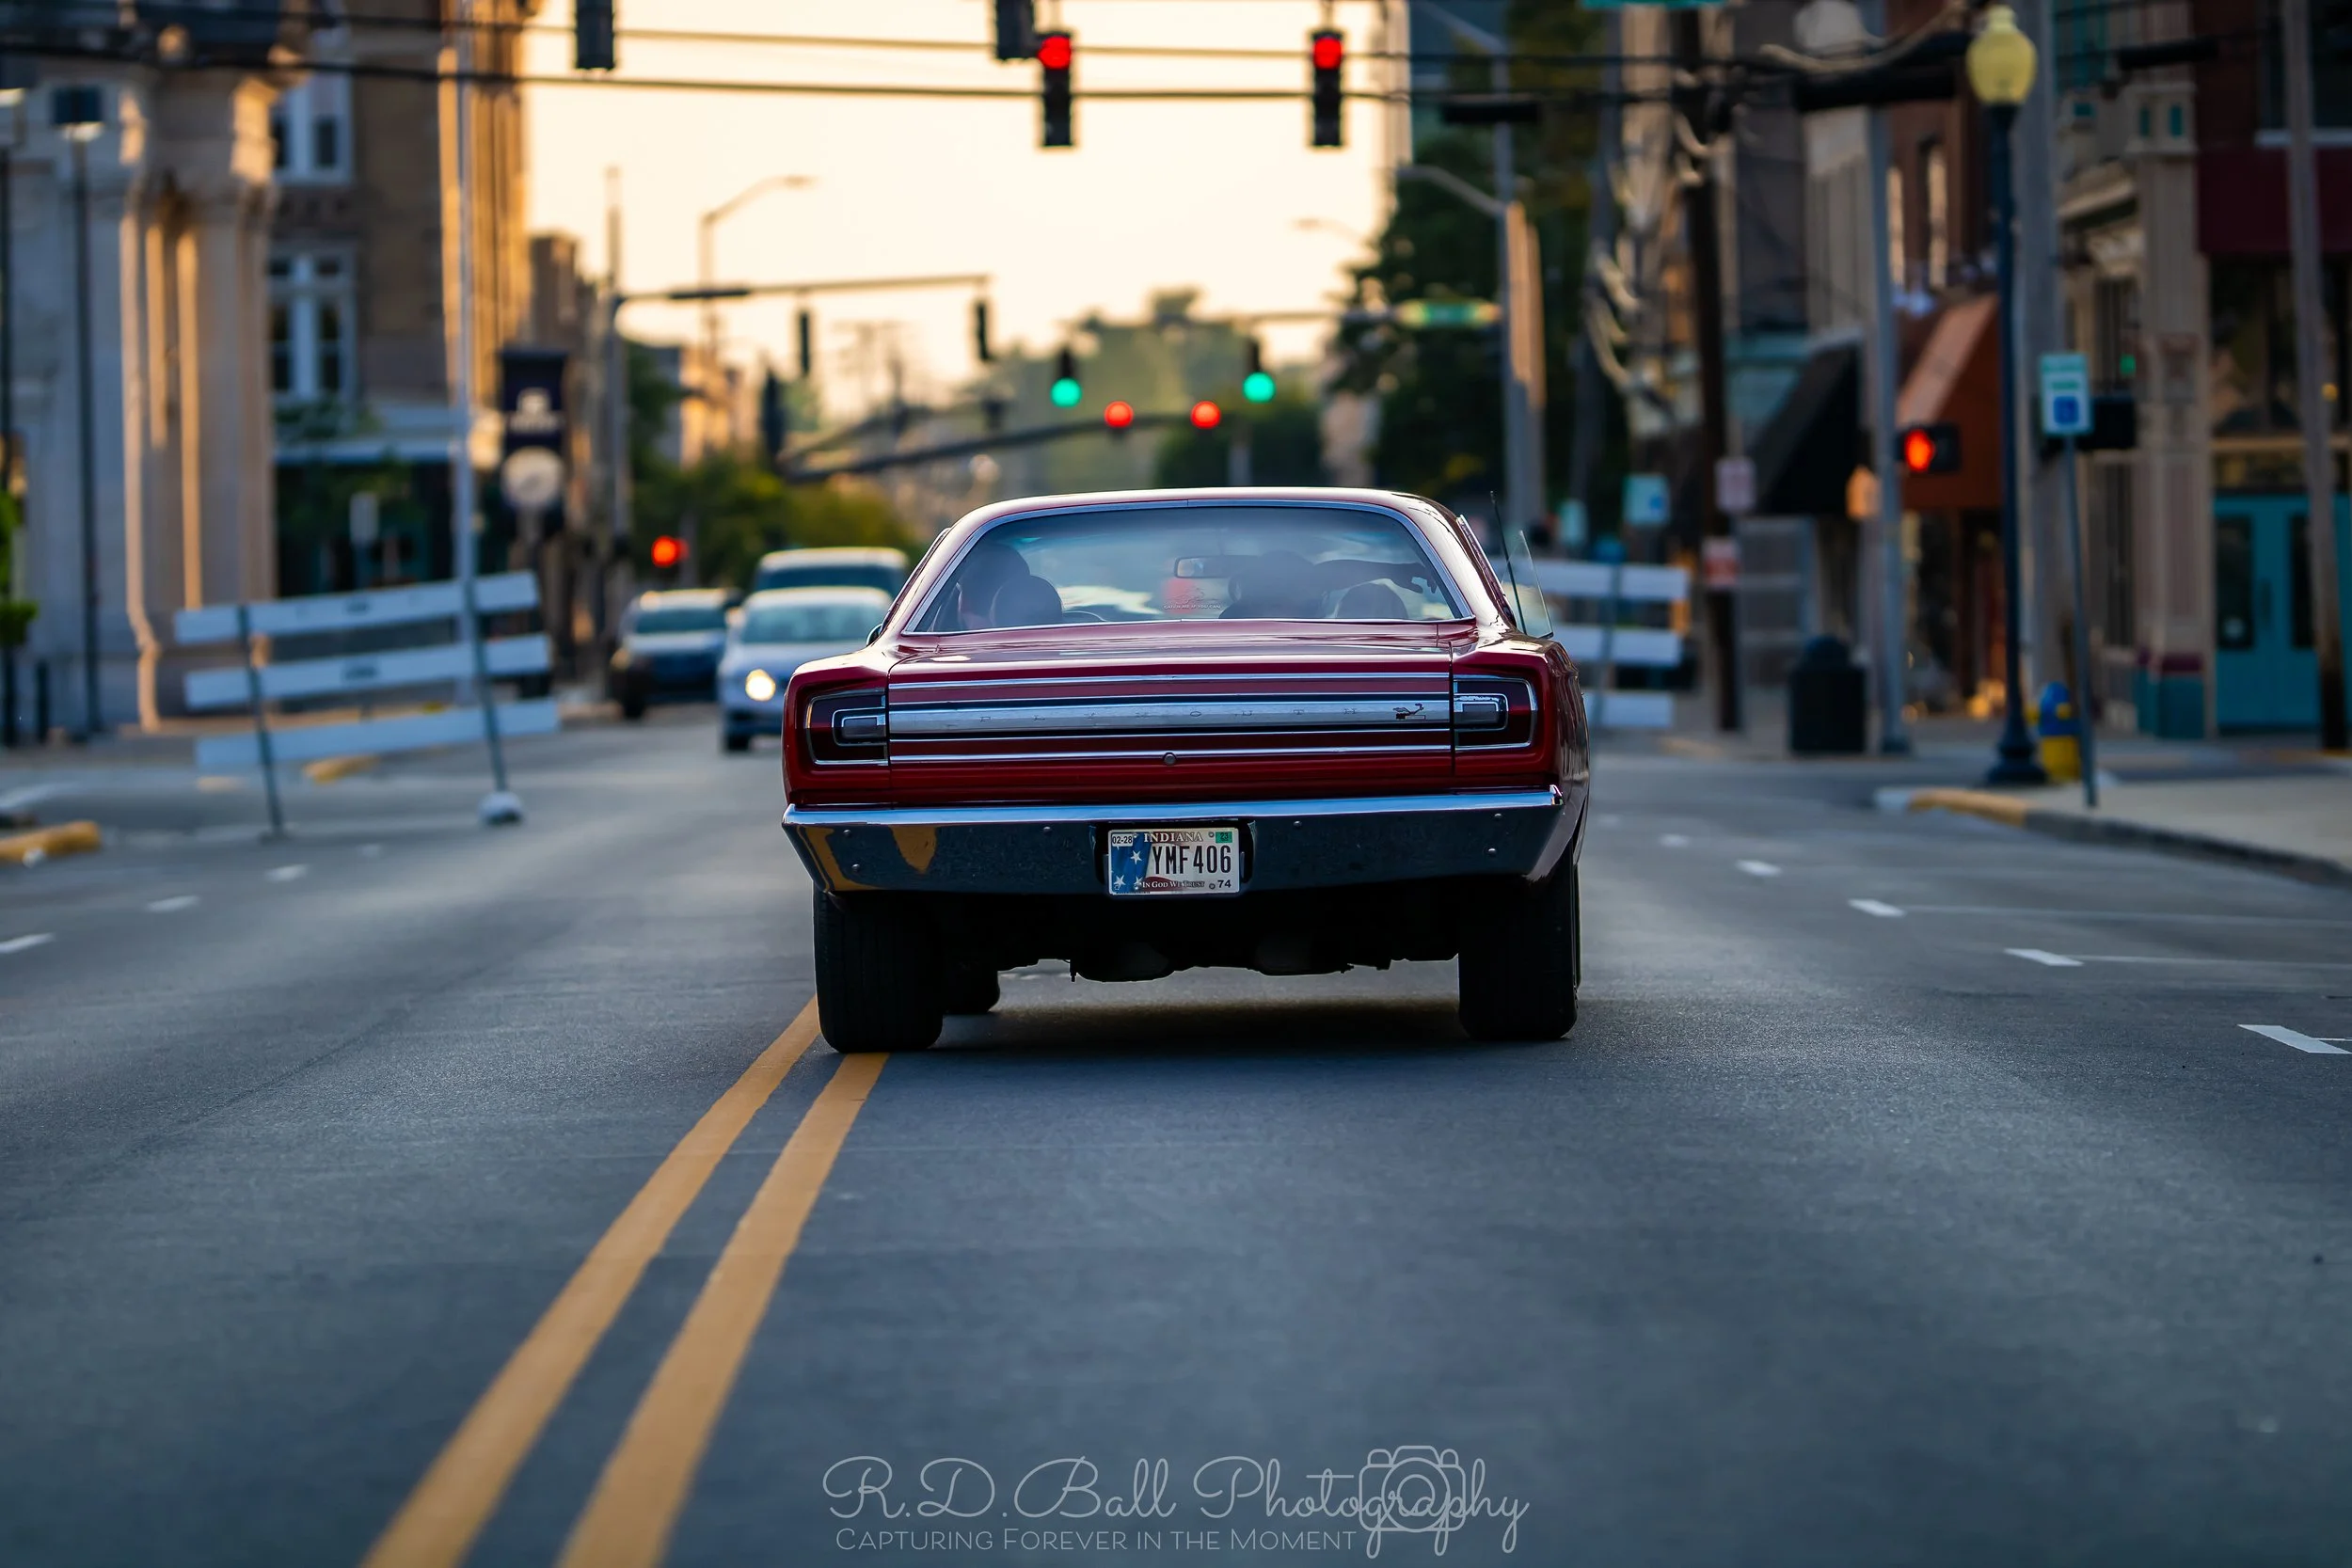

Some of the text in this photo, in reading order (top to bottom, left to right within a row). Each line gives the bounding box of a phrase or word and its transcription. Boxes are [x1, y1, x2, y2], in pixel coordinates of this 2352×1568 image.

[1112, 835, 1133, 845] 02-28
[1143, 832, 1204, 843] INDIANA
[1152, 846, 1232, 874] YMF406
[1217, 879, 1232, 888] 74
